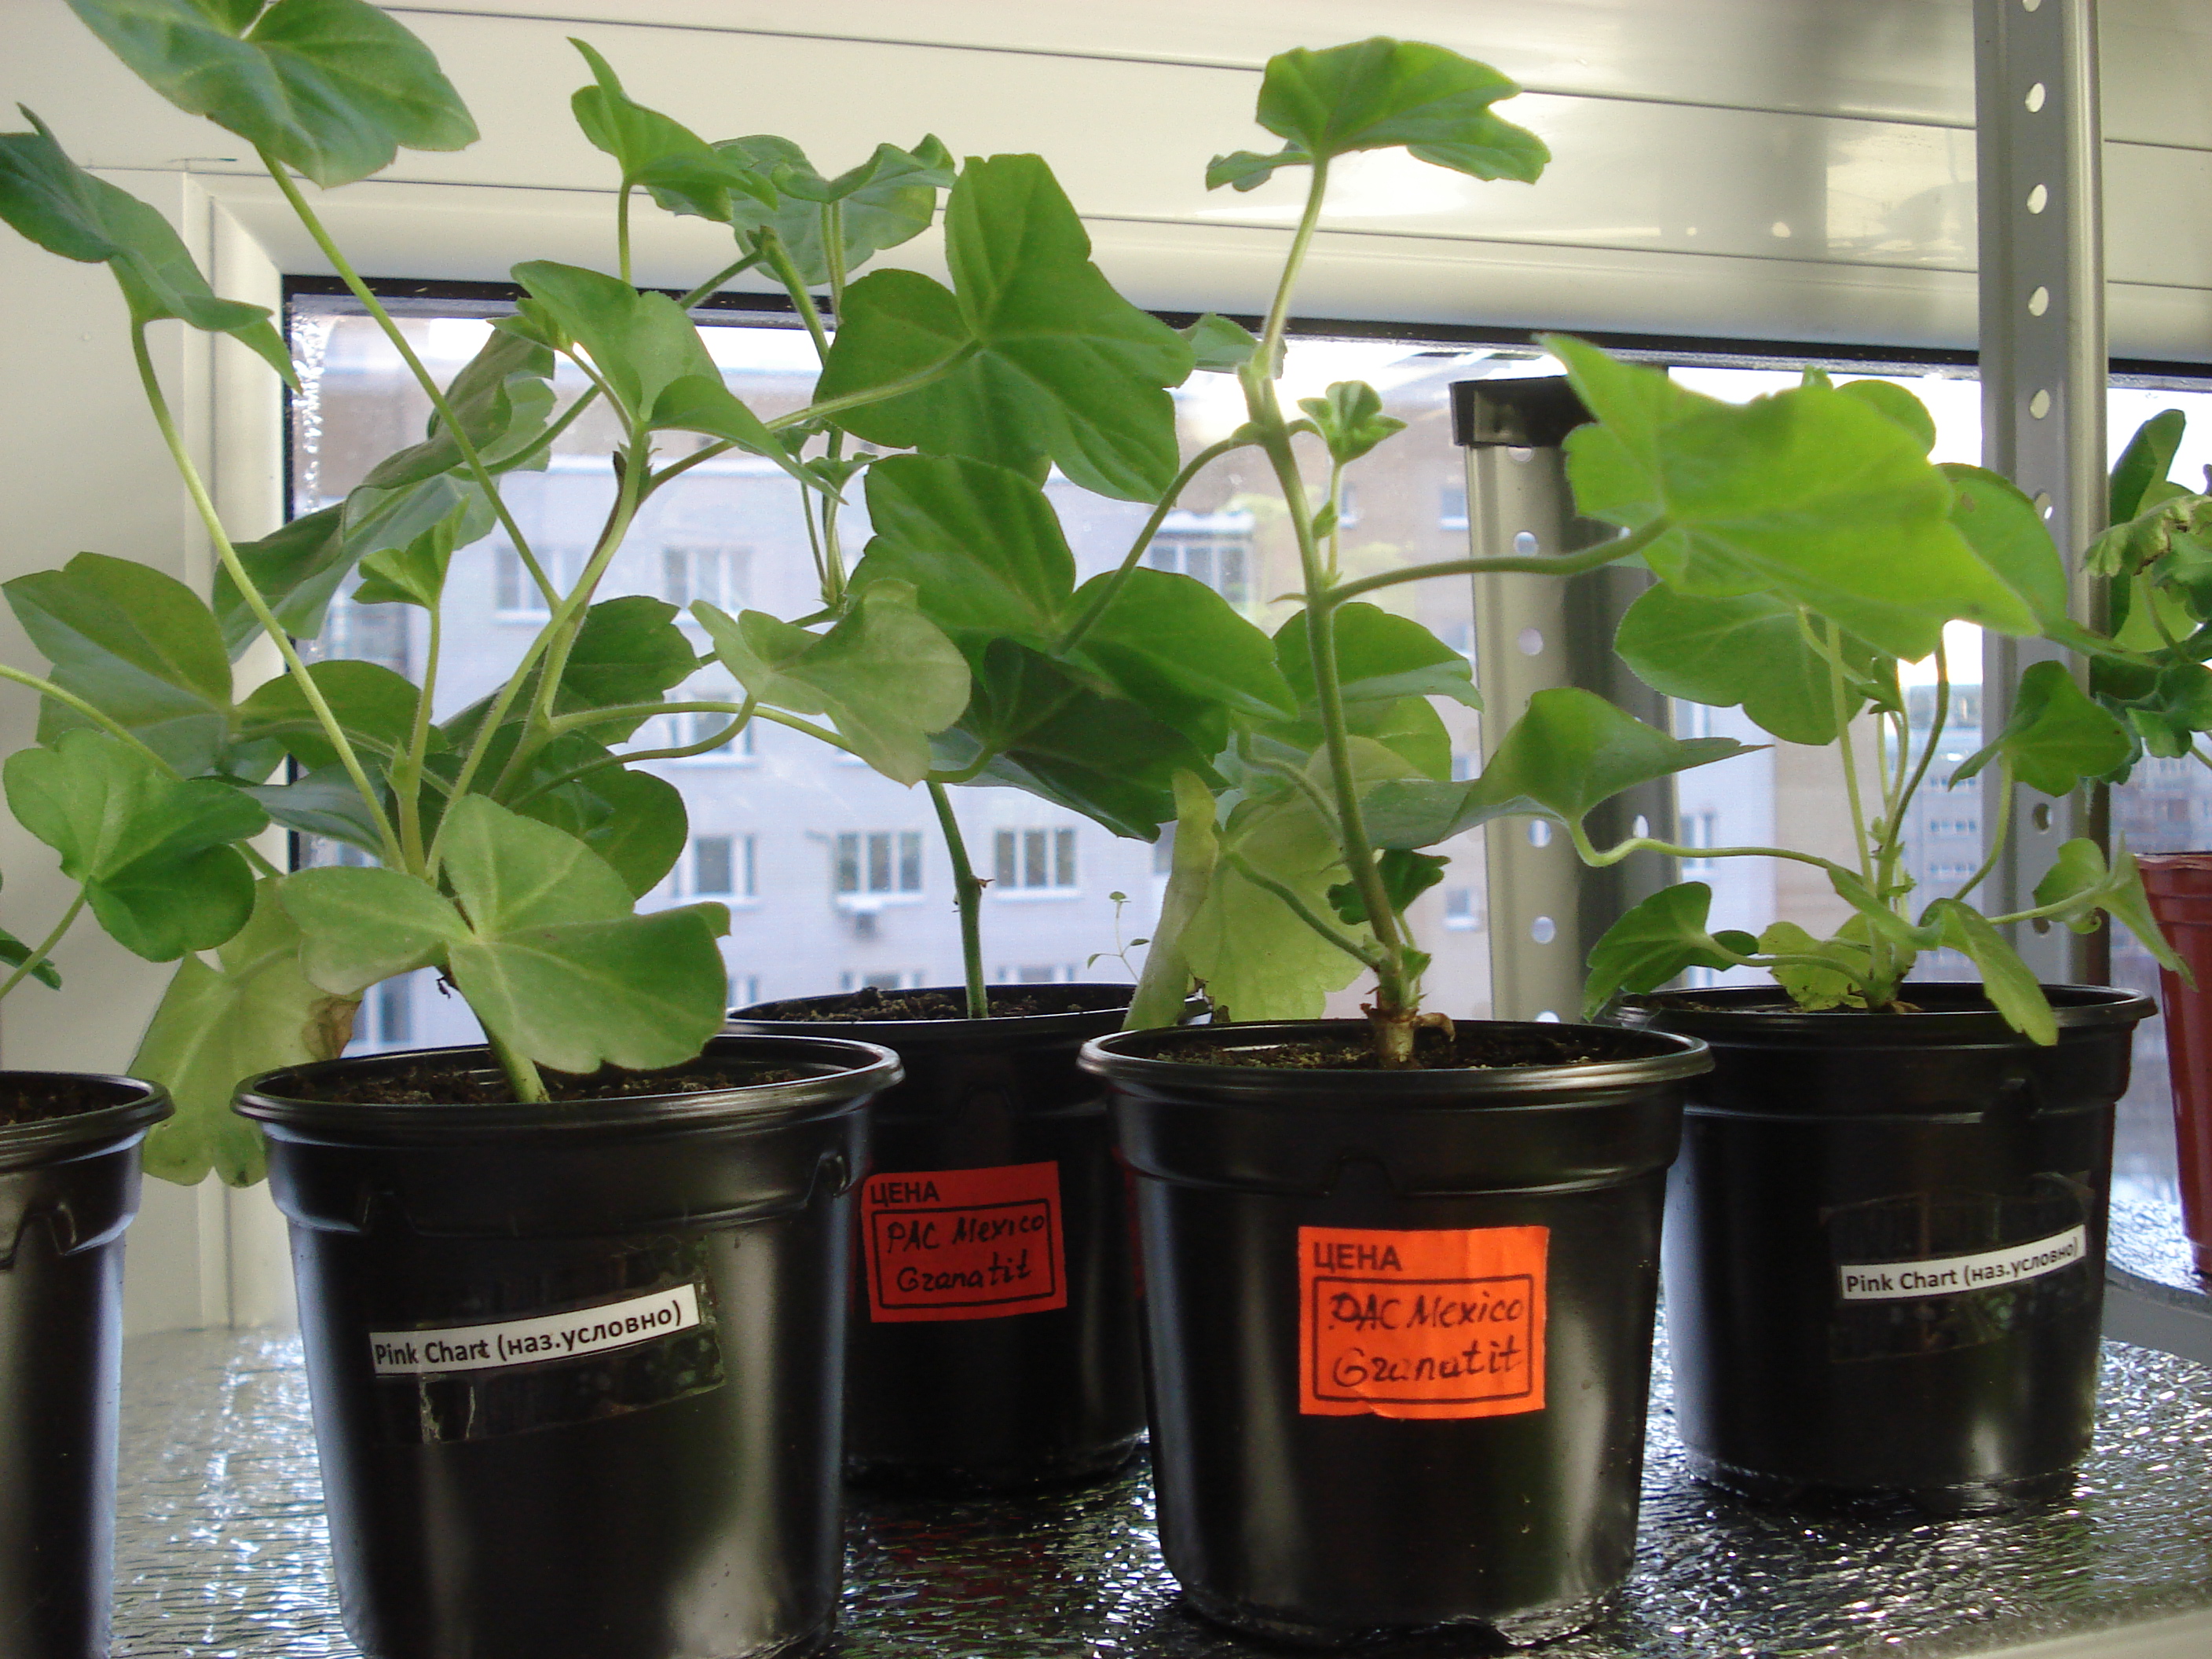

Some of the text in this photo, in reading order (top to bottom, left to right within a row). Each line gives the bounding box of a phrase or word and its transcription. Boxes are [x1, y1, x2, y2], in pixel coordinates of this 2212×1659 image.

[870, 1181, 940, 1207] ЦЕНА
[887, 1214, 1045, 1254] PAC Mexico
[1313, 1241, 1403, 1273] ЦЕНА
[1847, 1236, 2078, 1292] Pink Chart (наз.условно)
[1328, 1290, 1523, 1331] PAC Mexico
[375, 1299, 682, 1365] Pink Chart (наз.условно)
